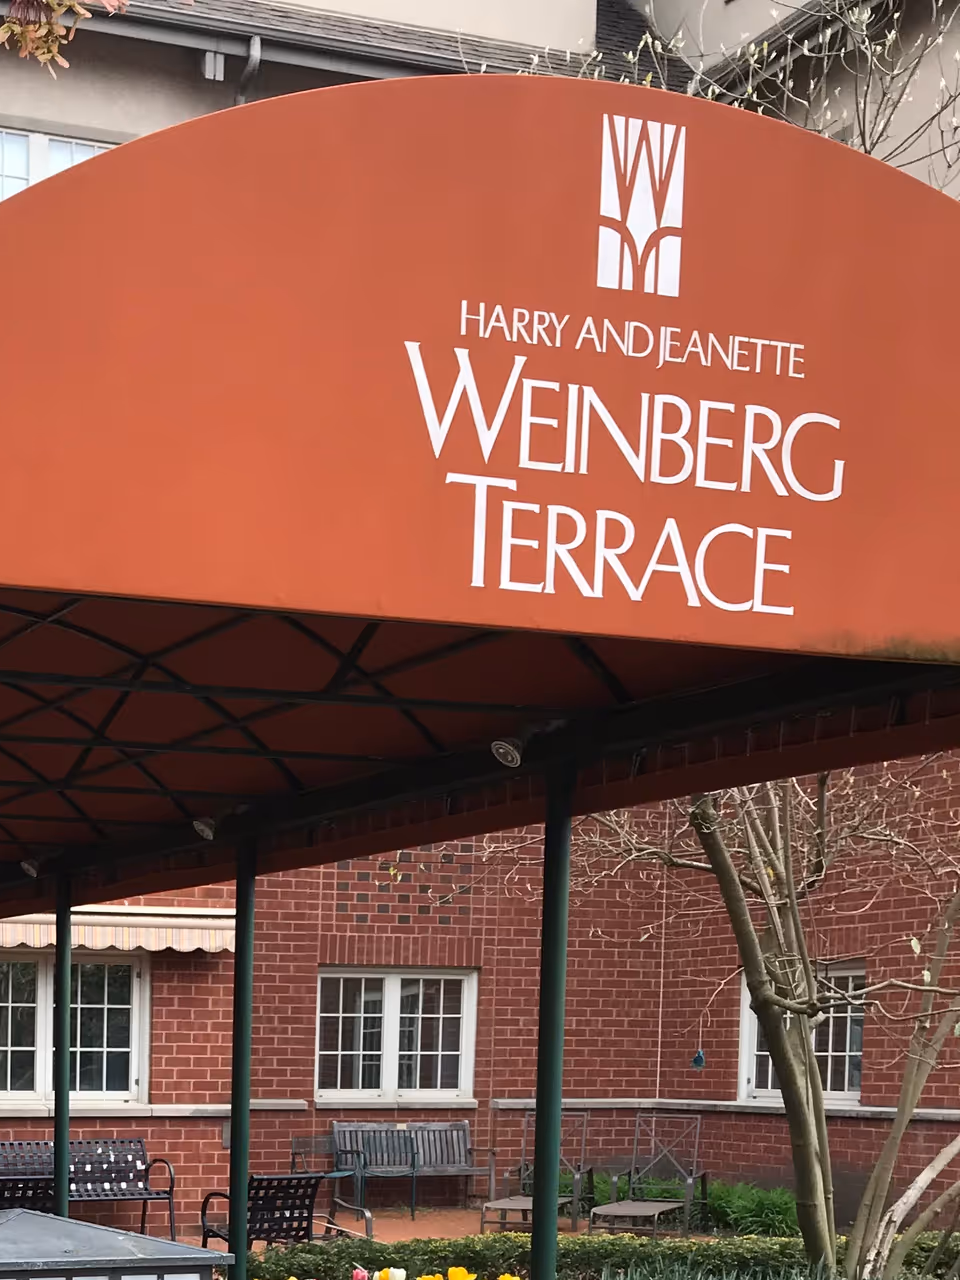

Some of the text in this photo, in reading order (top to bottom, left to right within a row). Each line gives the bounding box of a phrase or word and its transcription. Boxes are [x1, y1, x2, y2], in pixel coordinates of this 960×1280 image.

[460, 299, 805, 379] HARRY AND JEANETTE
[404, 340, 846, 502] WEINBERG
[445, 472, 795, 616] TERRACE
